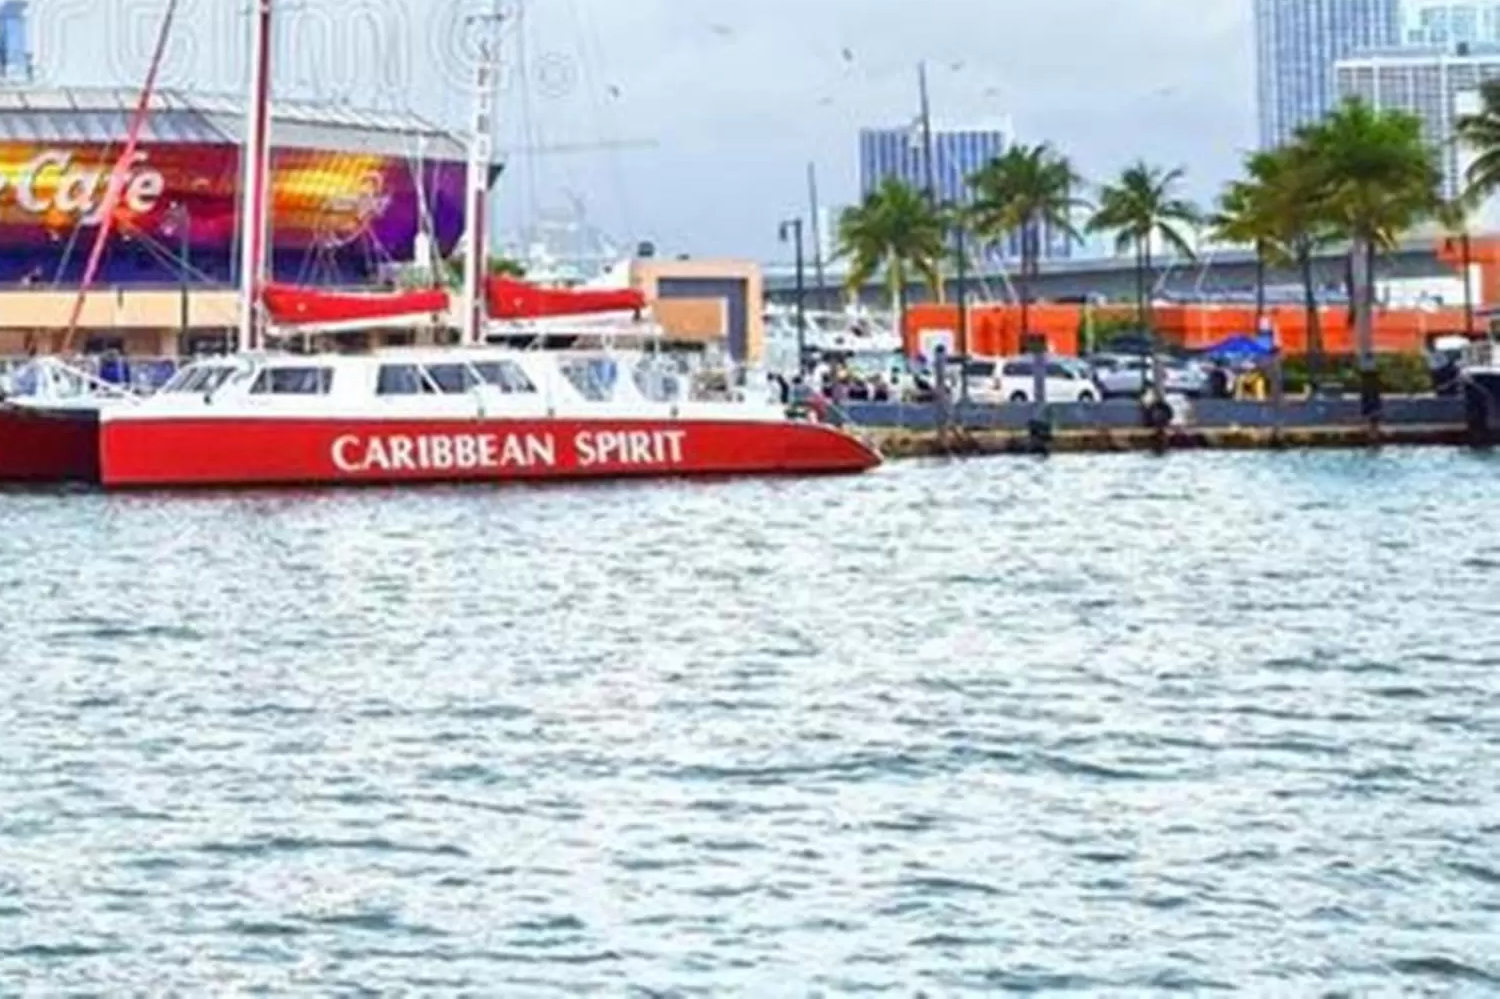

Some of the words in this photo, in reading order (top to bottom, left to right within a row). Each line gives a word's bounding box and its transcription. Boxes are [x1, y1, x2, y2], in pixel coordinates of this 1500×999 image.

[15, 149, 165, 226] Cafe
[331, 432, 555, 471] CARIBBEAN
[574, 429, 687, 467] SPIRIT
